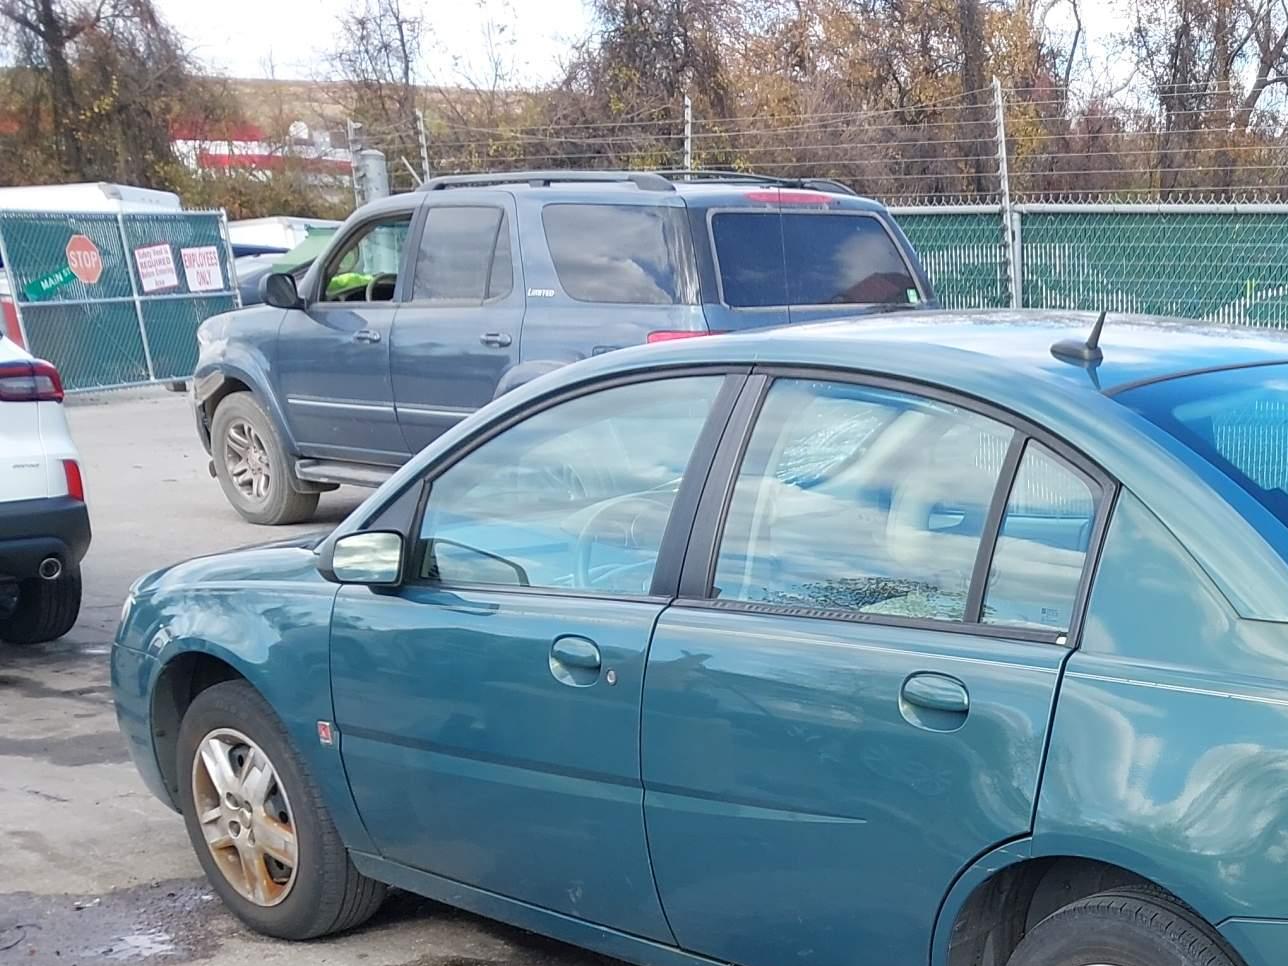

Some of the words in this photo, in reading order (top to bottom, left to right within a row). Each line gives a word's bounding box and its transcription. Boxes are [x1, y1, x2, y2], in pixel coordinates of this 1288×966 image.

[69, 250, 97, 269] STOP
[183, 250, 218, 269] EMPLOYEES
[40, 272, 63, 290] MAIN
[196, 269, 212, 287] ONLY
